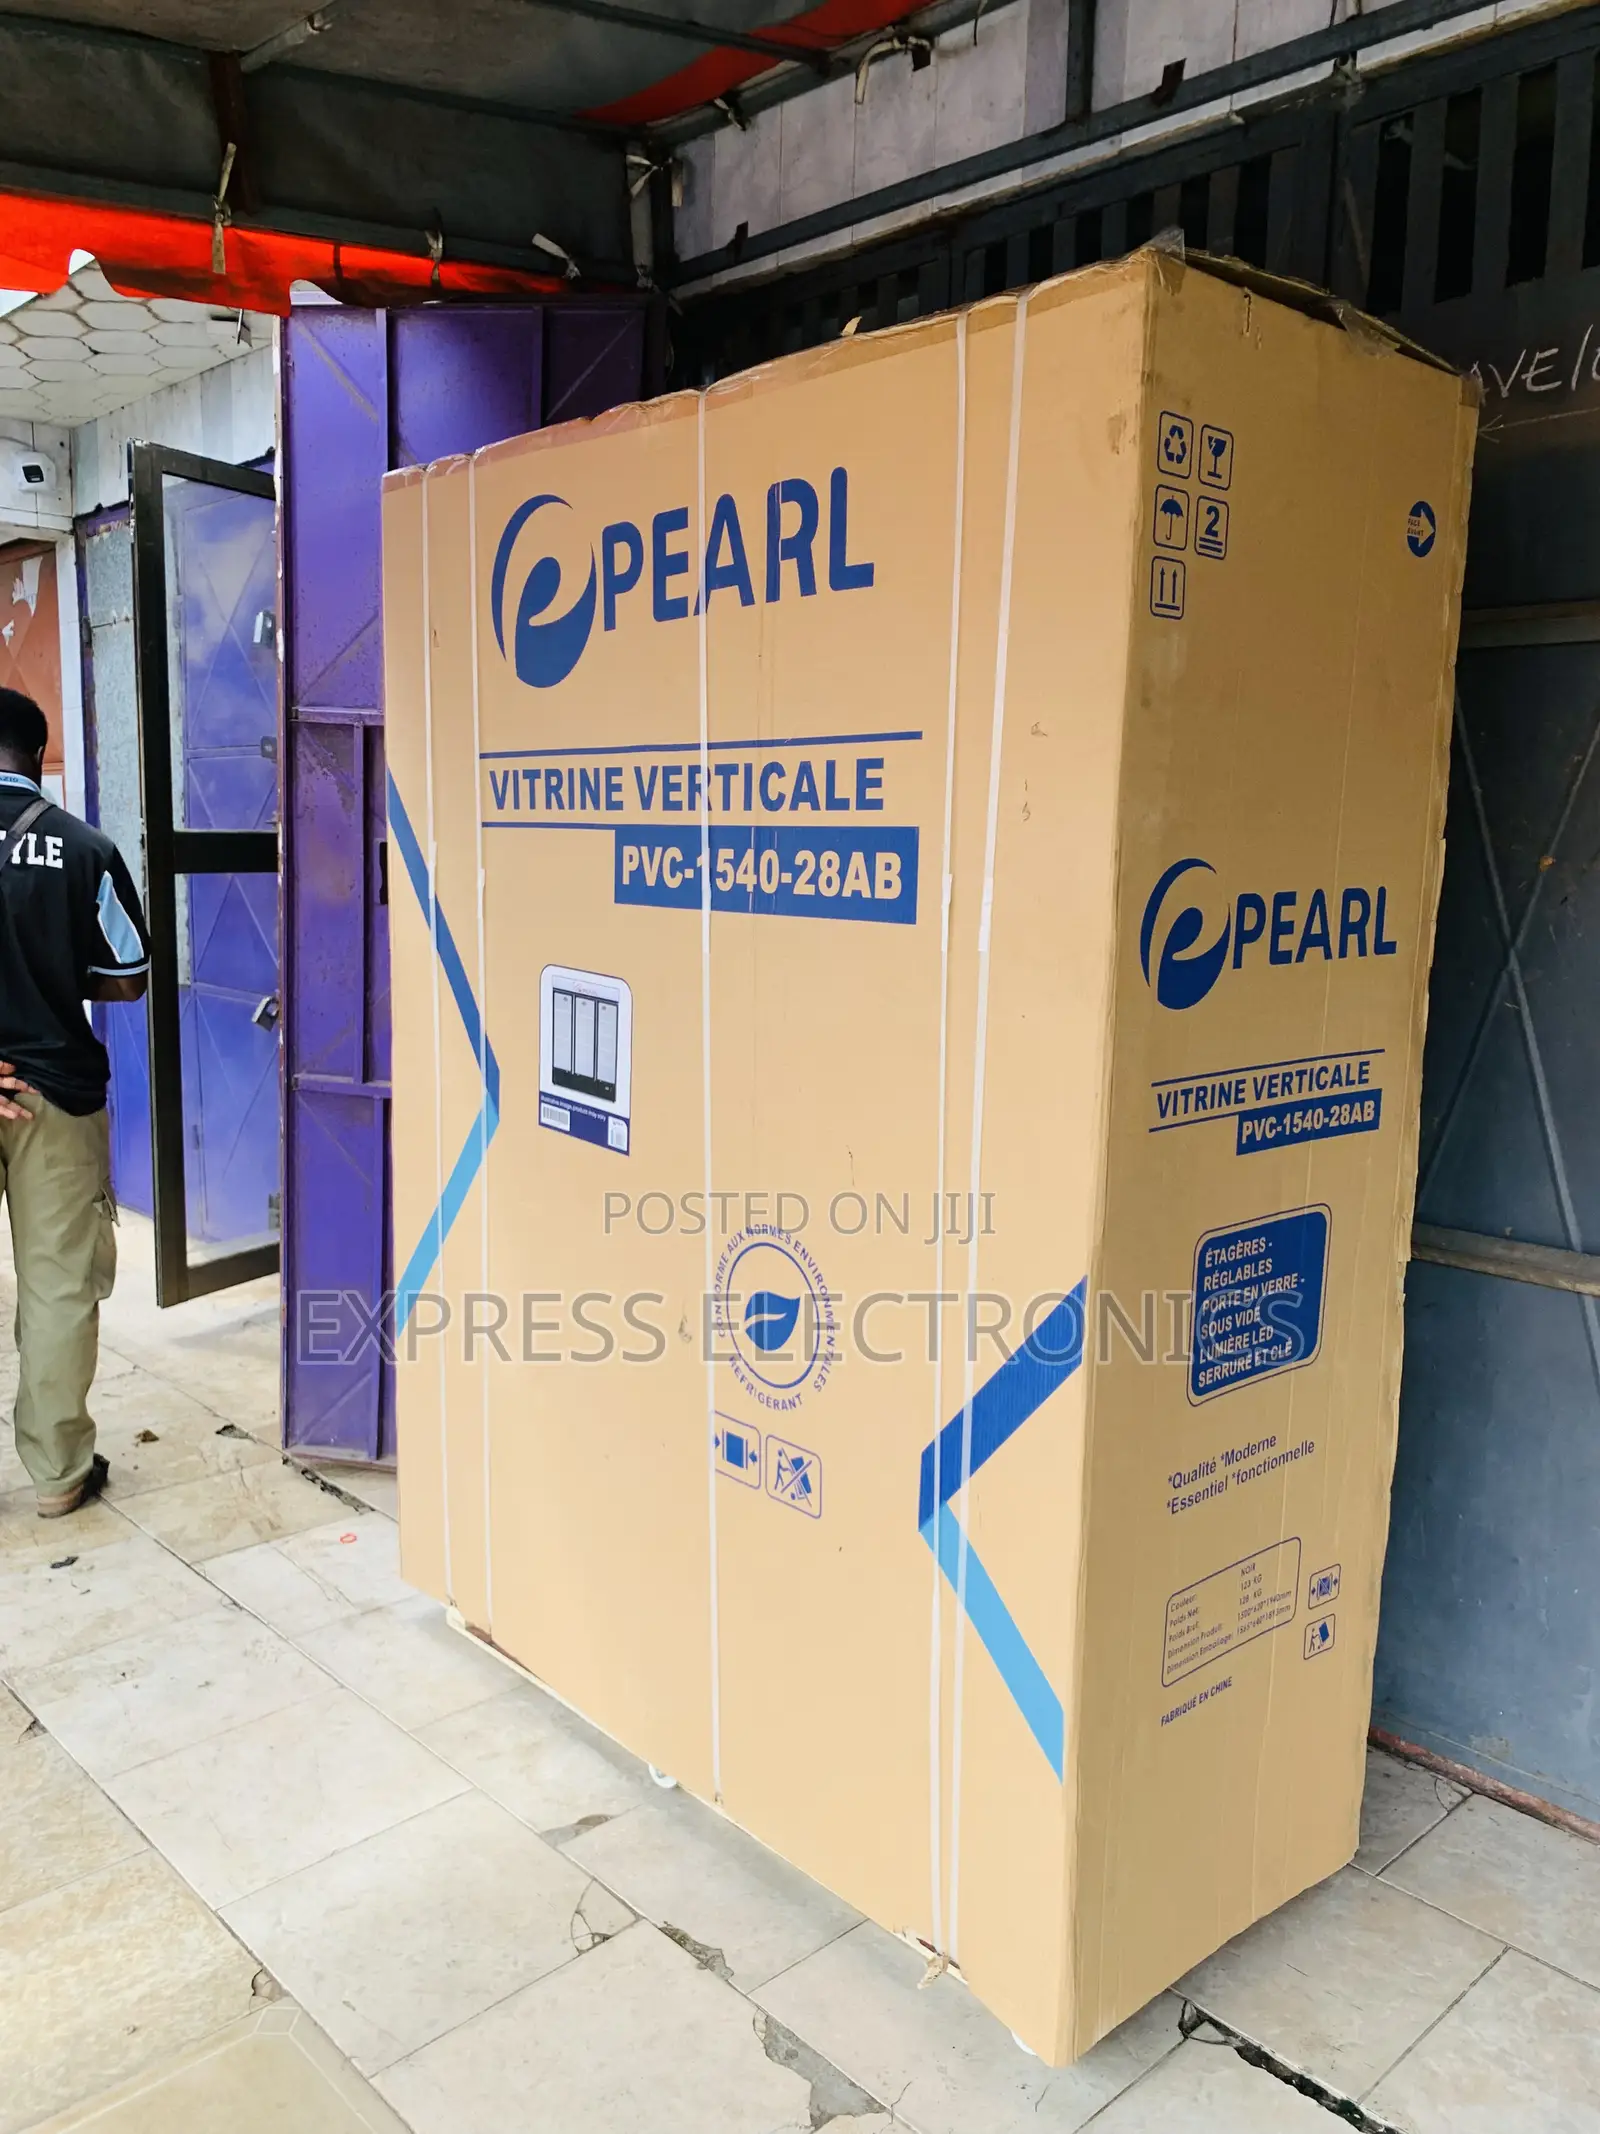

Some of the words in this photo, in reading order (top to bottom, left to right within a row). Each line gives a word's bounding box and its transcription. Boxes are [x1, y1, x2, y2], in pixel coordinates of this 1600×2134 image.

[1205, 505, 1220, 538] 2
[602, 466, 875, 632] PEARL
[489, 767, 624, 812] VITRINE
[634, 757, 885, 812] VERTICALE
[1232, 886, 1397, 970] PEARL
[1156, 1078, 1247, 1120] VITRINE
[1252, 1060, 1371, 1101] VERTICALE
[1241, 1100, 1375, 1144] PVC-1540-28AB
[727, 1230, 745, 1255] AUX
[745, 1223, 792, 1245] NORMES
[1205, 1237, 1266, 1268] ÉTAGÈRES
[1204, 1258, 1273, 1292] RÉGLABLES
[1202, 1290, 1242, 1316] PORTE
[1243, 1286, 1259, 1304] EN
[1261, 1273, 1299, 1297] VERRE
[1201, 1317, 1233, 1340] SOUS
[1200, 1334, 1249, 1364] LUMIÈRE
[1198, 1358, 1253, 1388] SERRURE
[1254, 1349, 1268, 1367] ET
[1198, 1688, 1209, 1705] EN
[1210, 1676, 1233, 1698] CHINE
